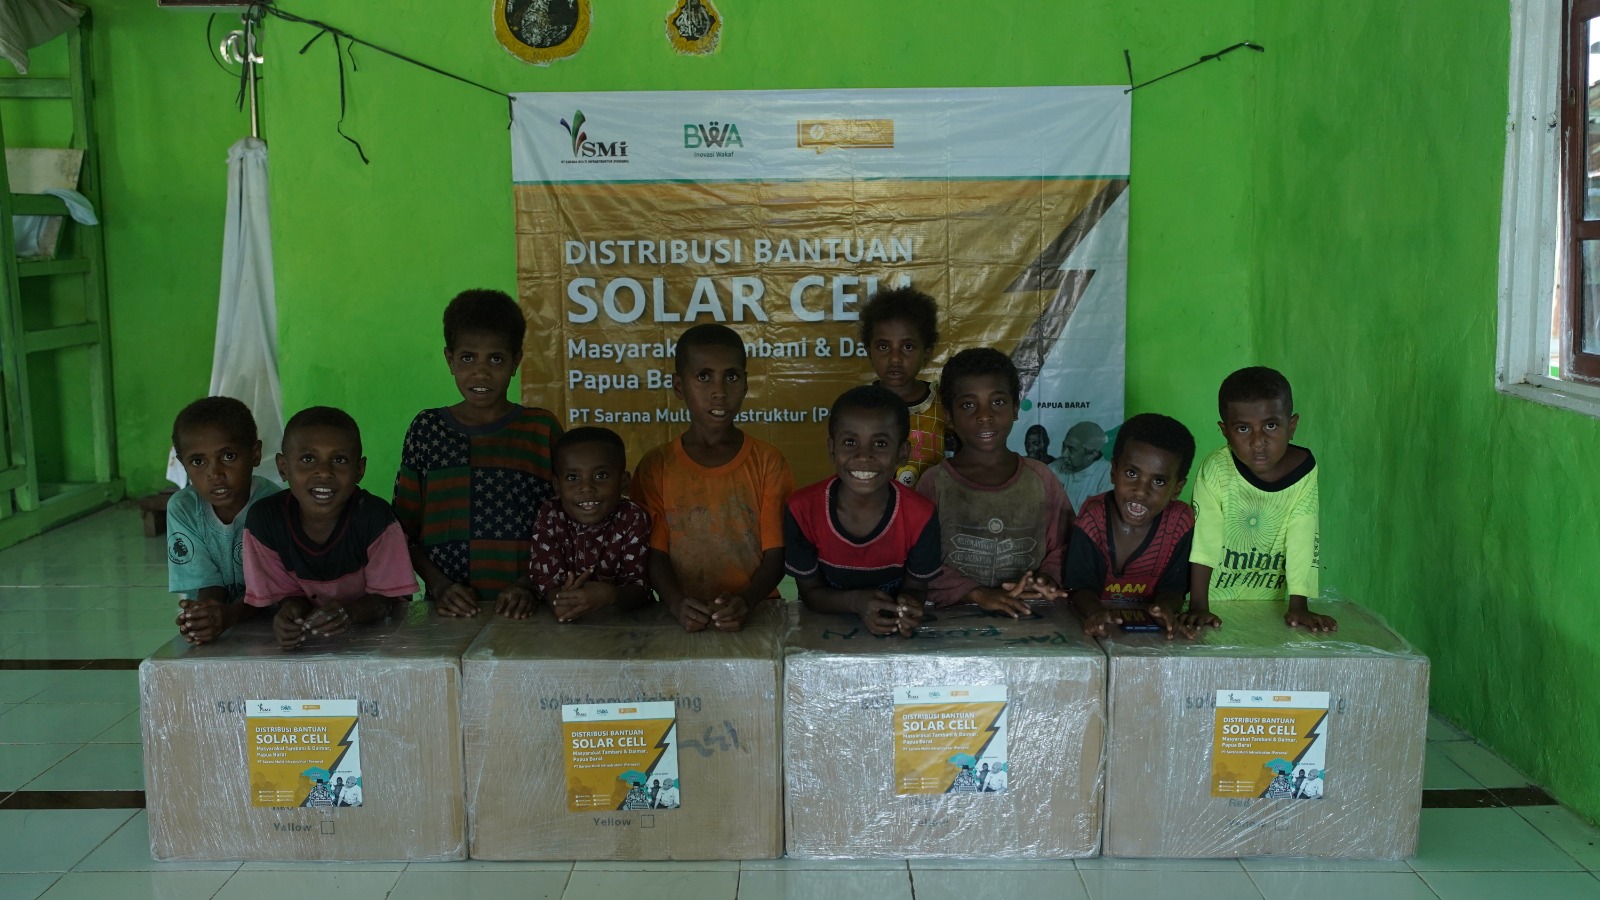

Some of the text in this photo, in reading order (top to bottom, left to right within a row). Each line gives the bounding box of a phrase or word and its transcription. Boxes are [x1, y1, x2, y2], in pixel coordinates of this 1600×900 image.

[684, 121, 744, 148] BWA
[565, 238, 913, 265] DISTRIBUSI BANTUAN
[567, 277, 769, 324] SOLAR
[568, 337, 867, 363] Masyarak mbani & Da
[568, 370, 674, 393] Papua Ba
[569, 409, 590, 423] PT
[594, 409, 651, 423] Sarana
[655, 409, 691, 423] Mult
[734, 408, 807, 422] astruktur
[903, 720, 977, 731] SOLAR CELL
[1222, 724, 1297, 735] SOLAR CELL
[256, 734, 330, 744] SOLAR CELL
[572, 737, 647, 749] SOLAR CELL
[274, 823, 312, 832] Yellow
[593, 817, 632, 827] Yellow
